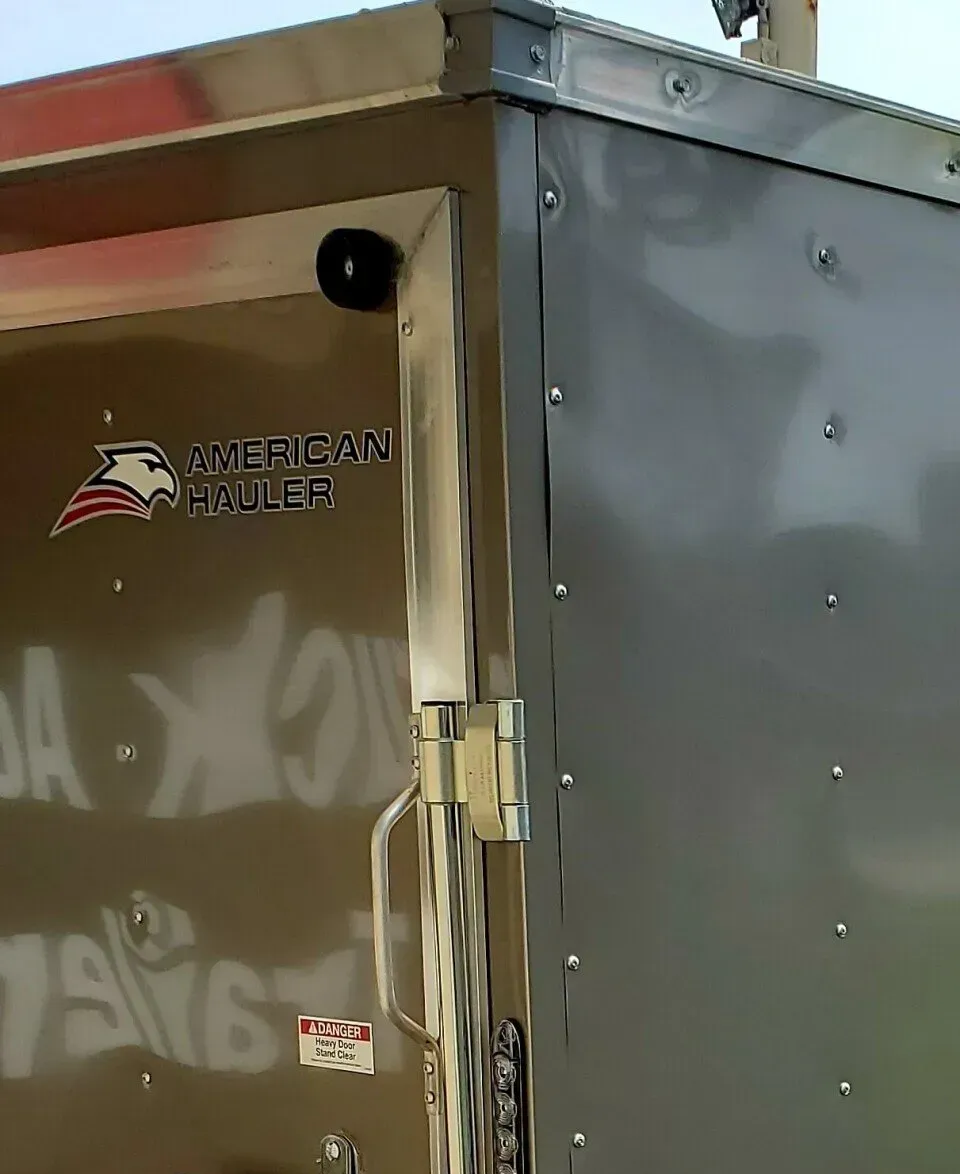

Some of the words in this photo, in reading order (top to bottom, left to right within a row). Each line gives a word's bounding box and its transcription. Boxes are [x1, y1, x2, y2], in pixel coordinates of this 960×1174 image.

[185, 427, 393, 476] AMERICAN
[186, 475, 335, 518] HAULER
[318, 1022, 361, 1038] DANGER
[315, 1037, 337, 1049] Heavy
[338, 1040, 356, 1050] Door
[316, 1048, 336, 1058] Stand
[337, 1050, 356, 1060] Clear
